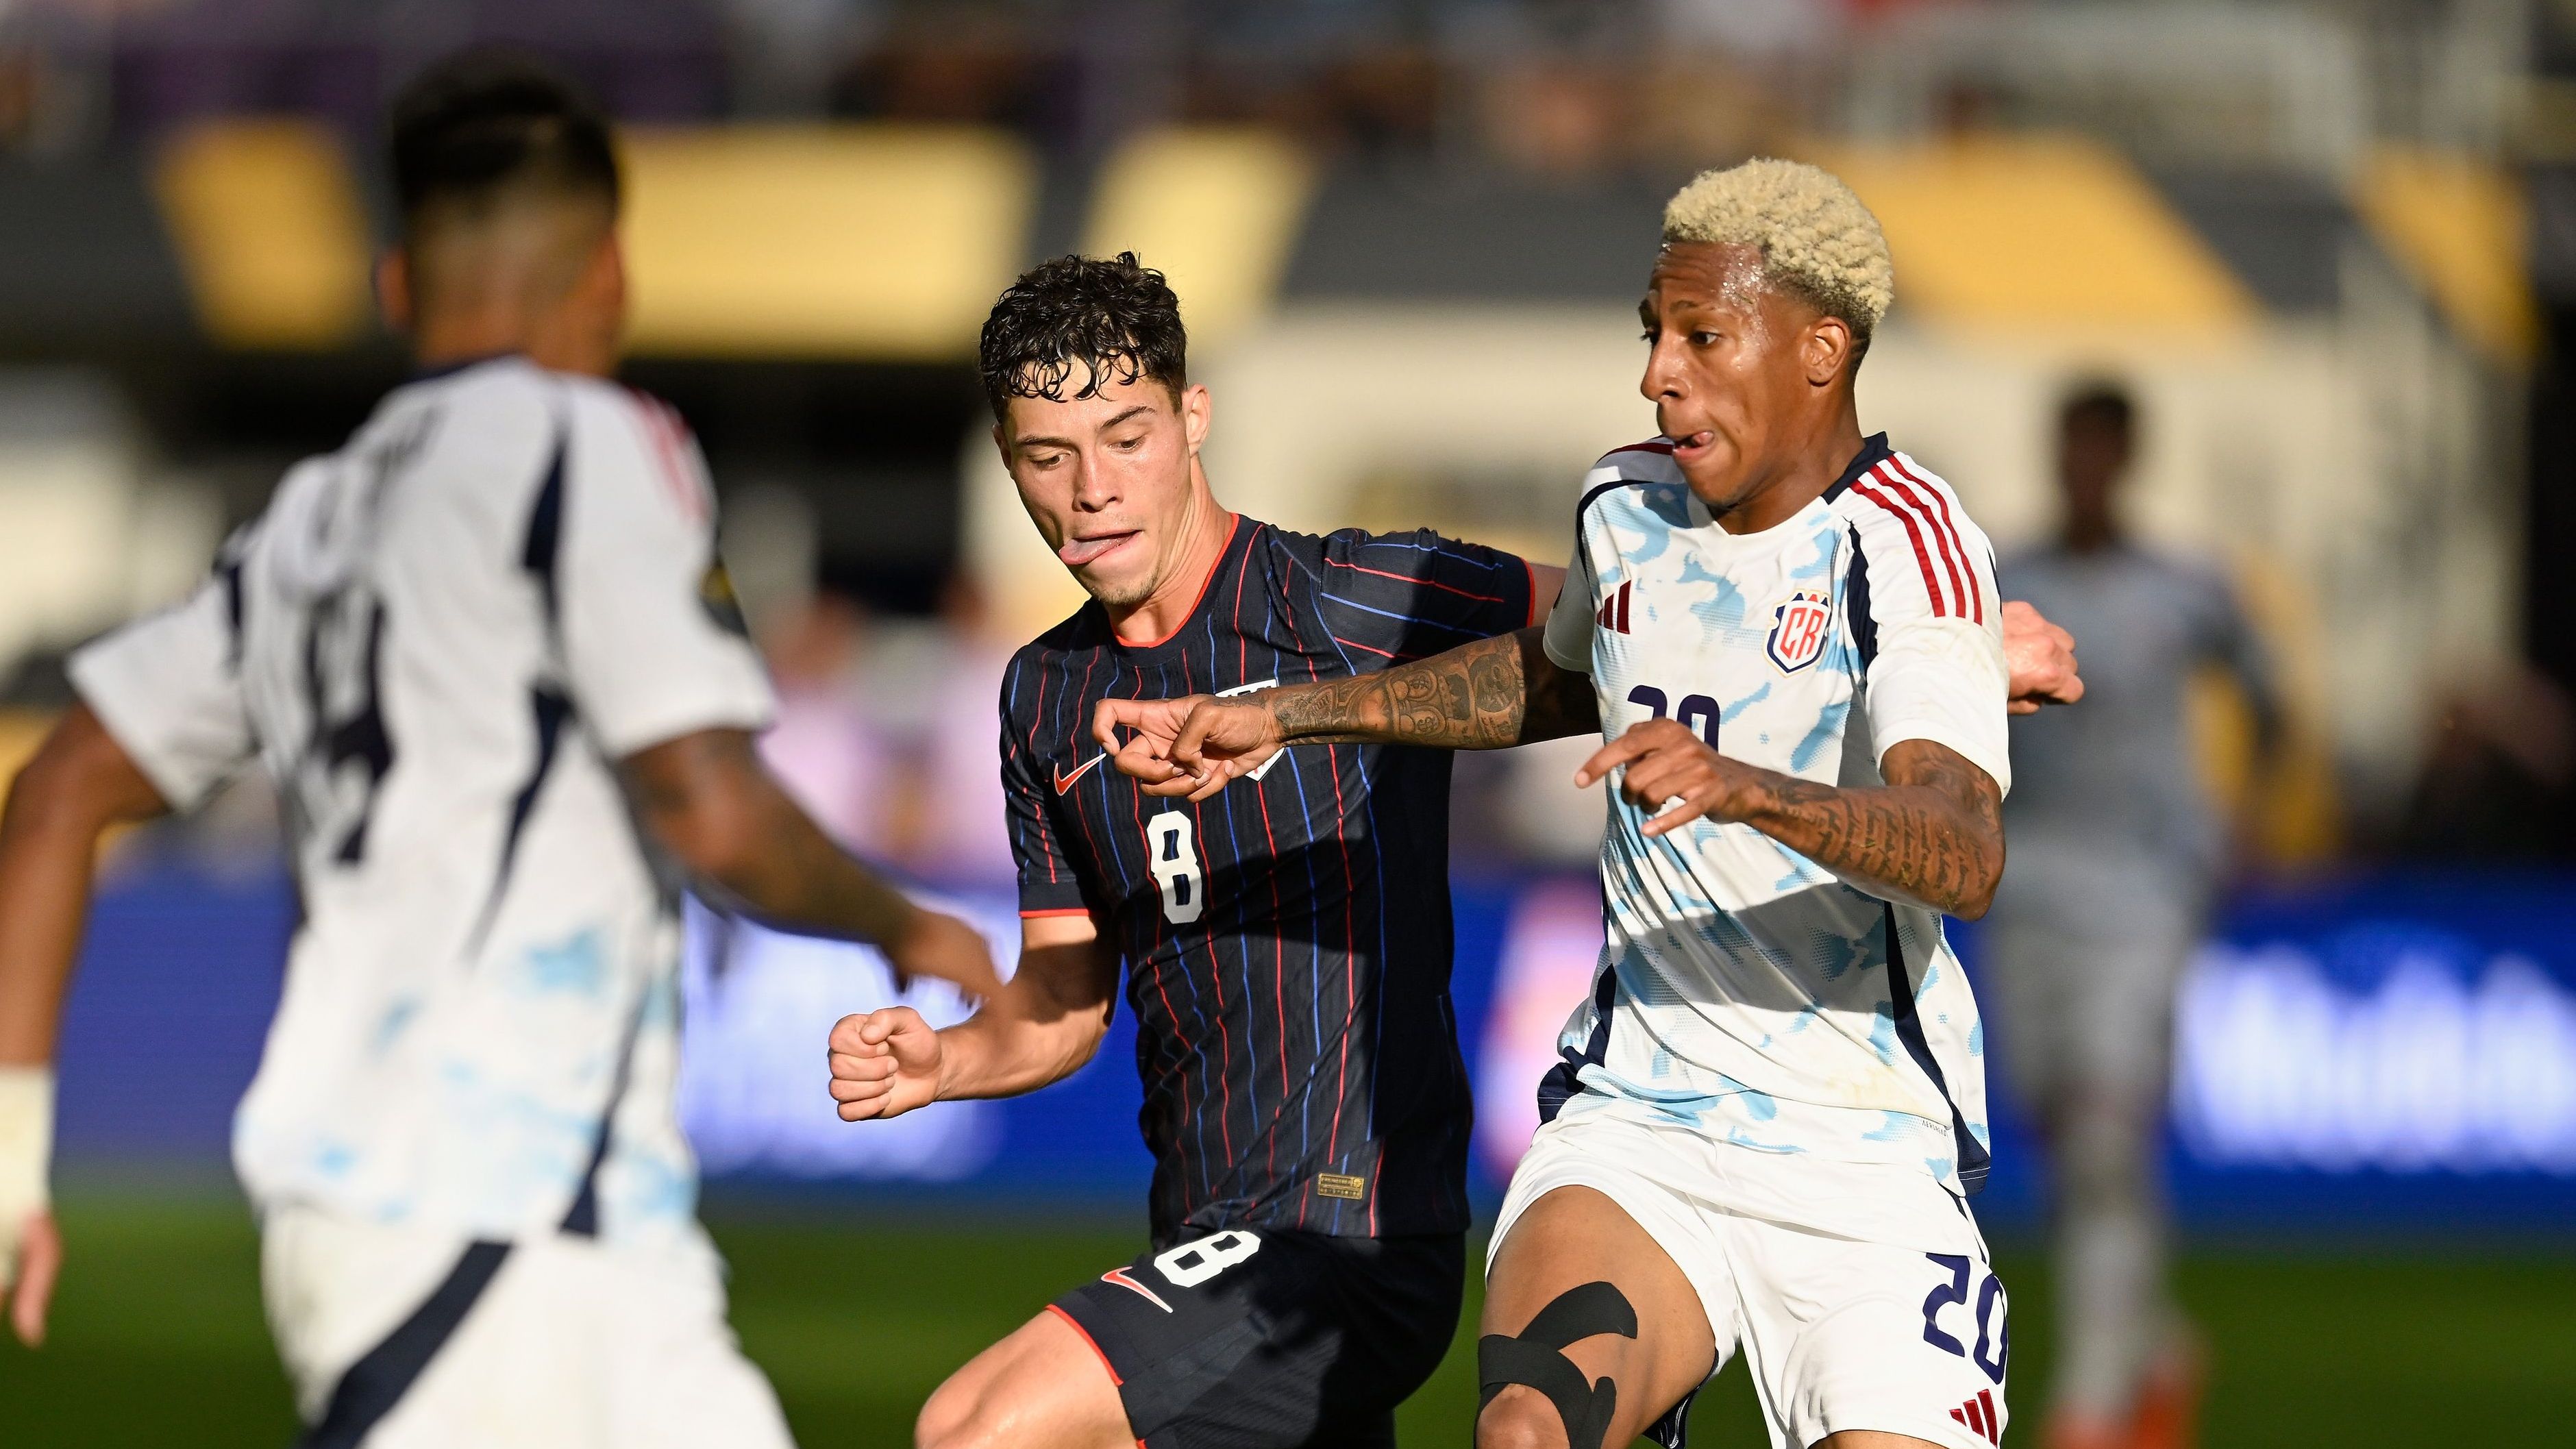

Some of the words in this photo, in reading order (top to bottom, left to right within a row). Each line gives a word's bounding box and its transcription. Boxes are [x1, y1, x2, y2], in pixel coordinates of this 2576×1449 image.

[1780, 607, 1824, 660] CR
[1146, 810, 1203, 925] 8
[1153, 1230, 1261, 1288] 8
[1922, 1252, 2008, 1385] 20
